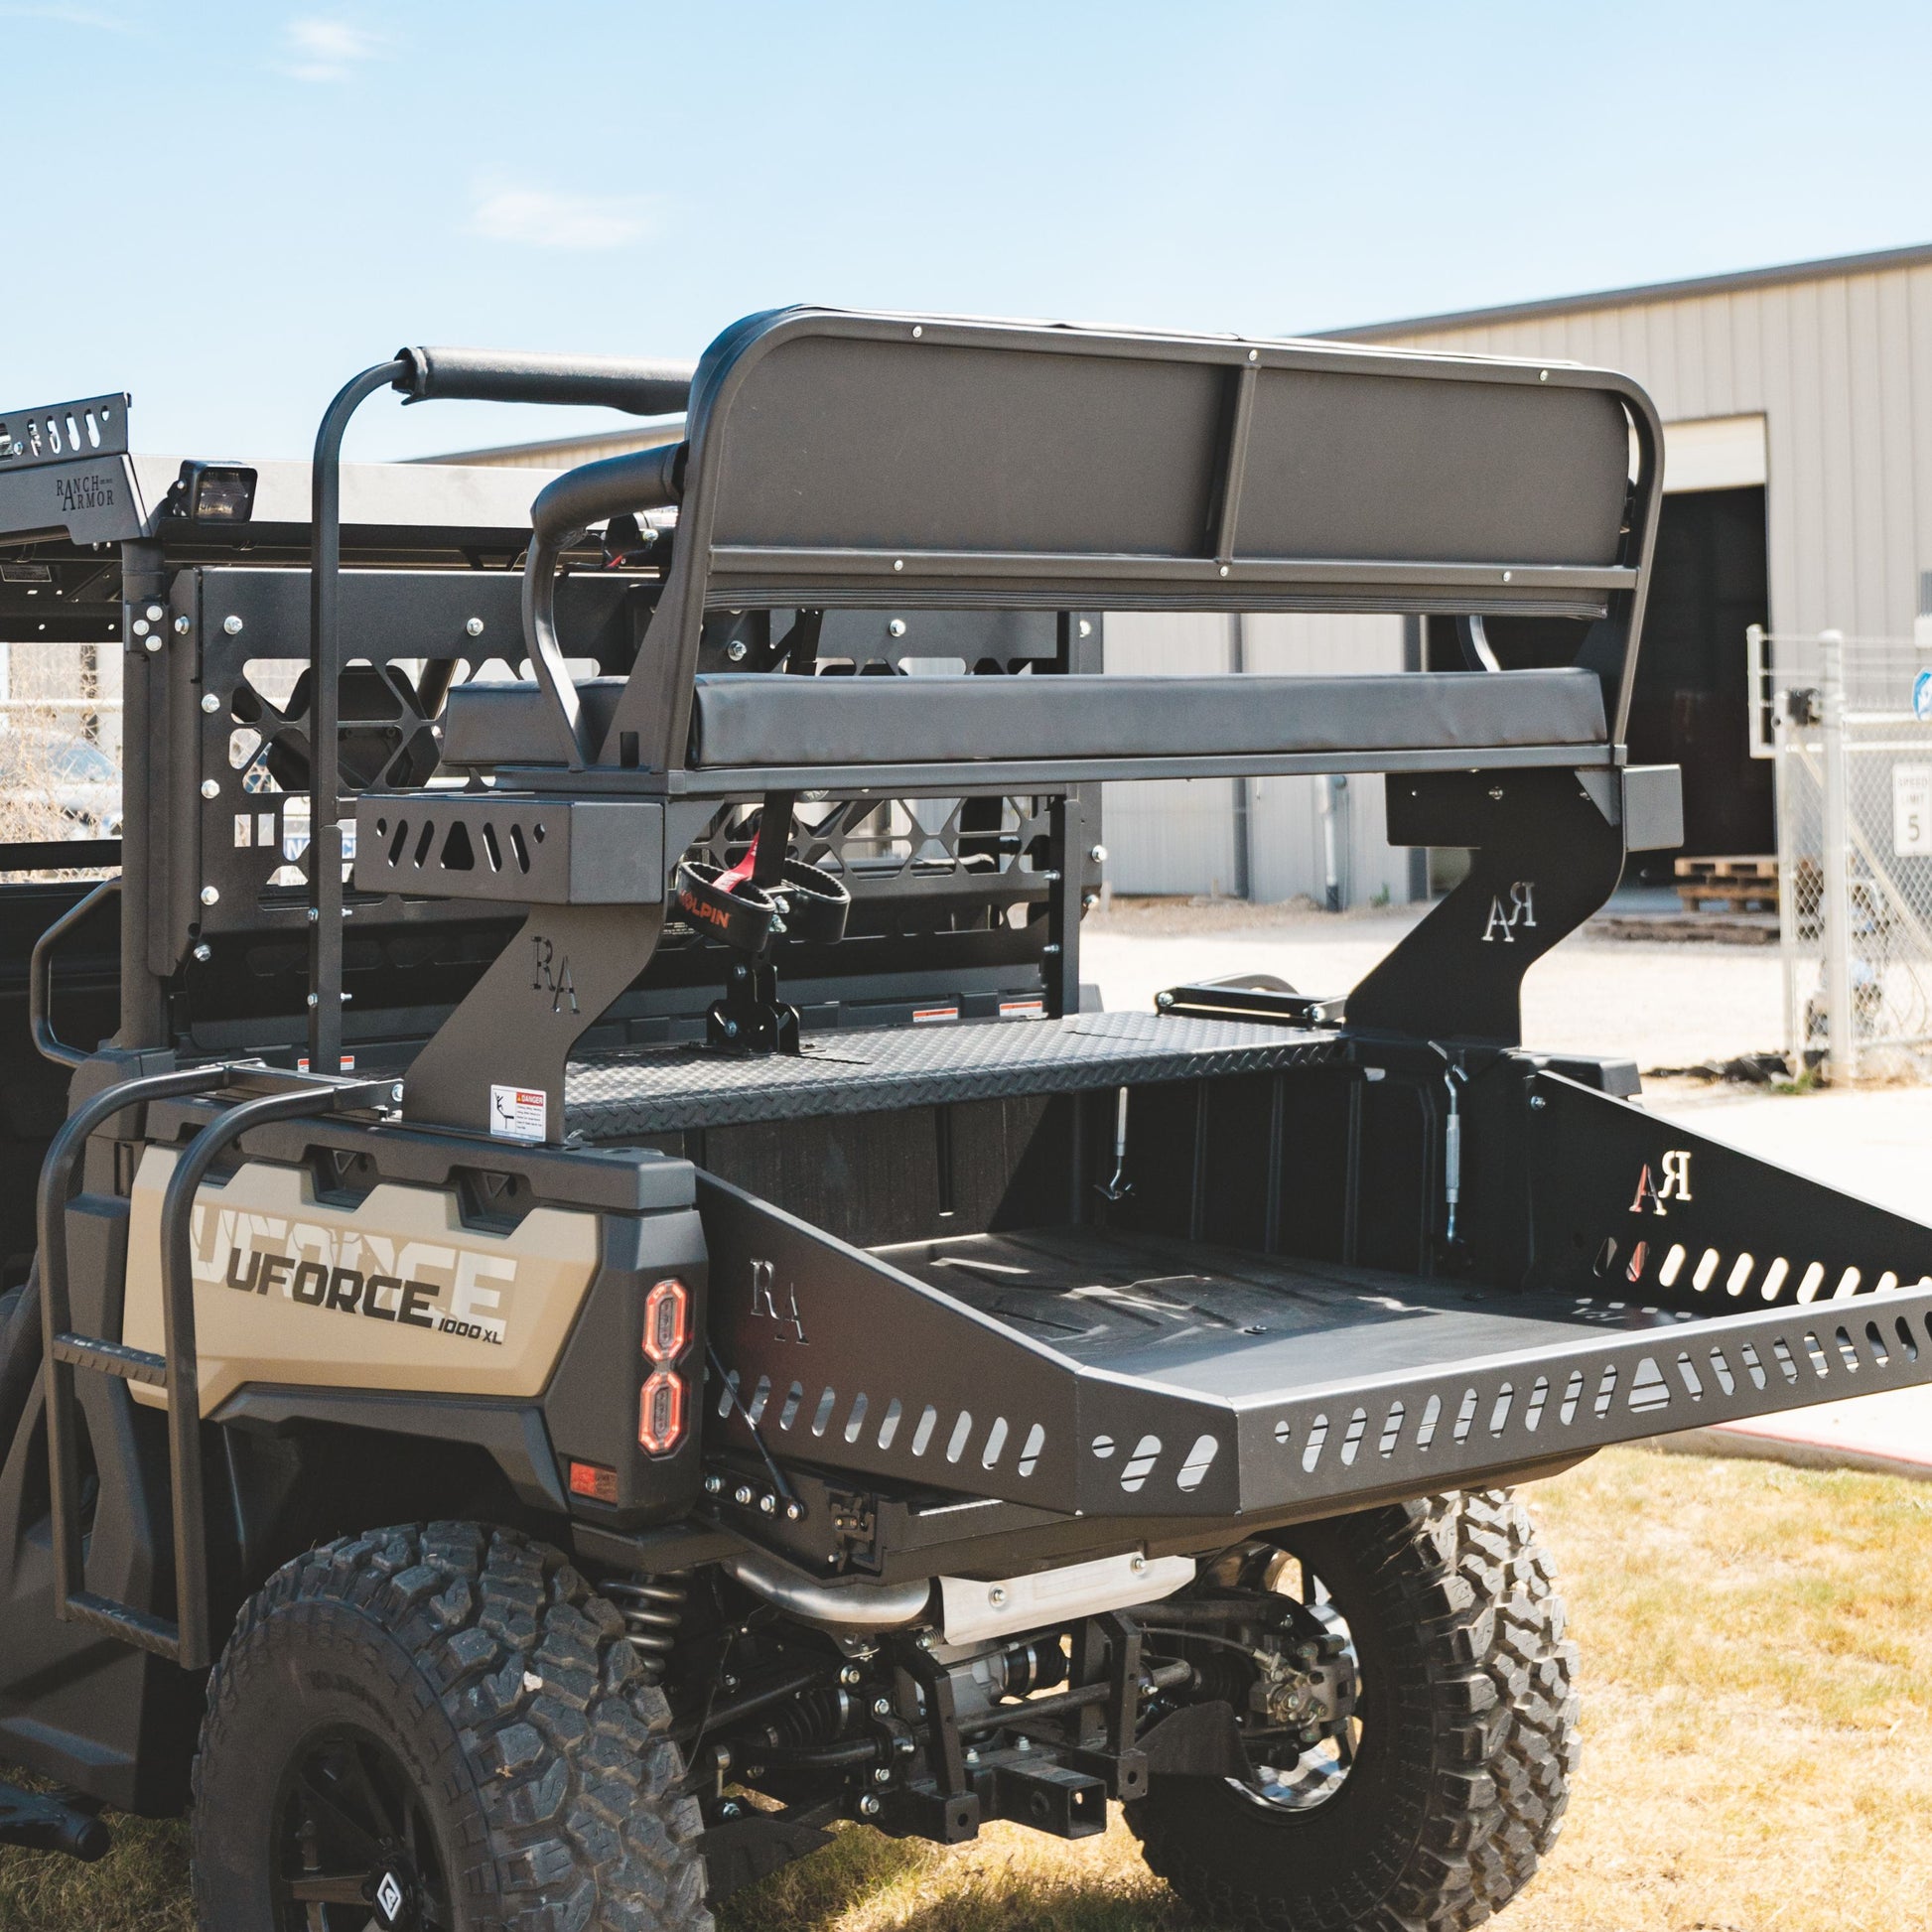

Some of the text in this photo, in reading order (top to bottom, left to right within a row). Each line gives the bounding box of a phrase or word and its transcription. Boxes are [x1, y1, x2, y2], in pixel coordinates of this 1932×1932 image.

[57, 475, 99, 502] RANCH
[62, 480, 114, 511] ARMOR
[1908, 814, 1920, 842] 5
[531, 936, 581, 1014] RA
[226, 1247, 440, 1328] UFORCE
[438, 1318, 503, 1345] 1000 XL
